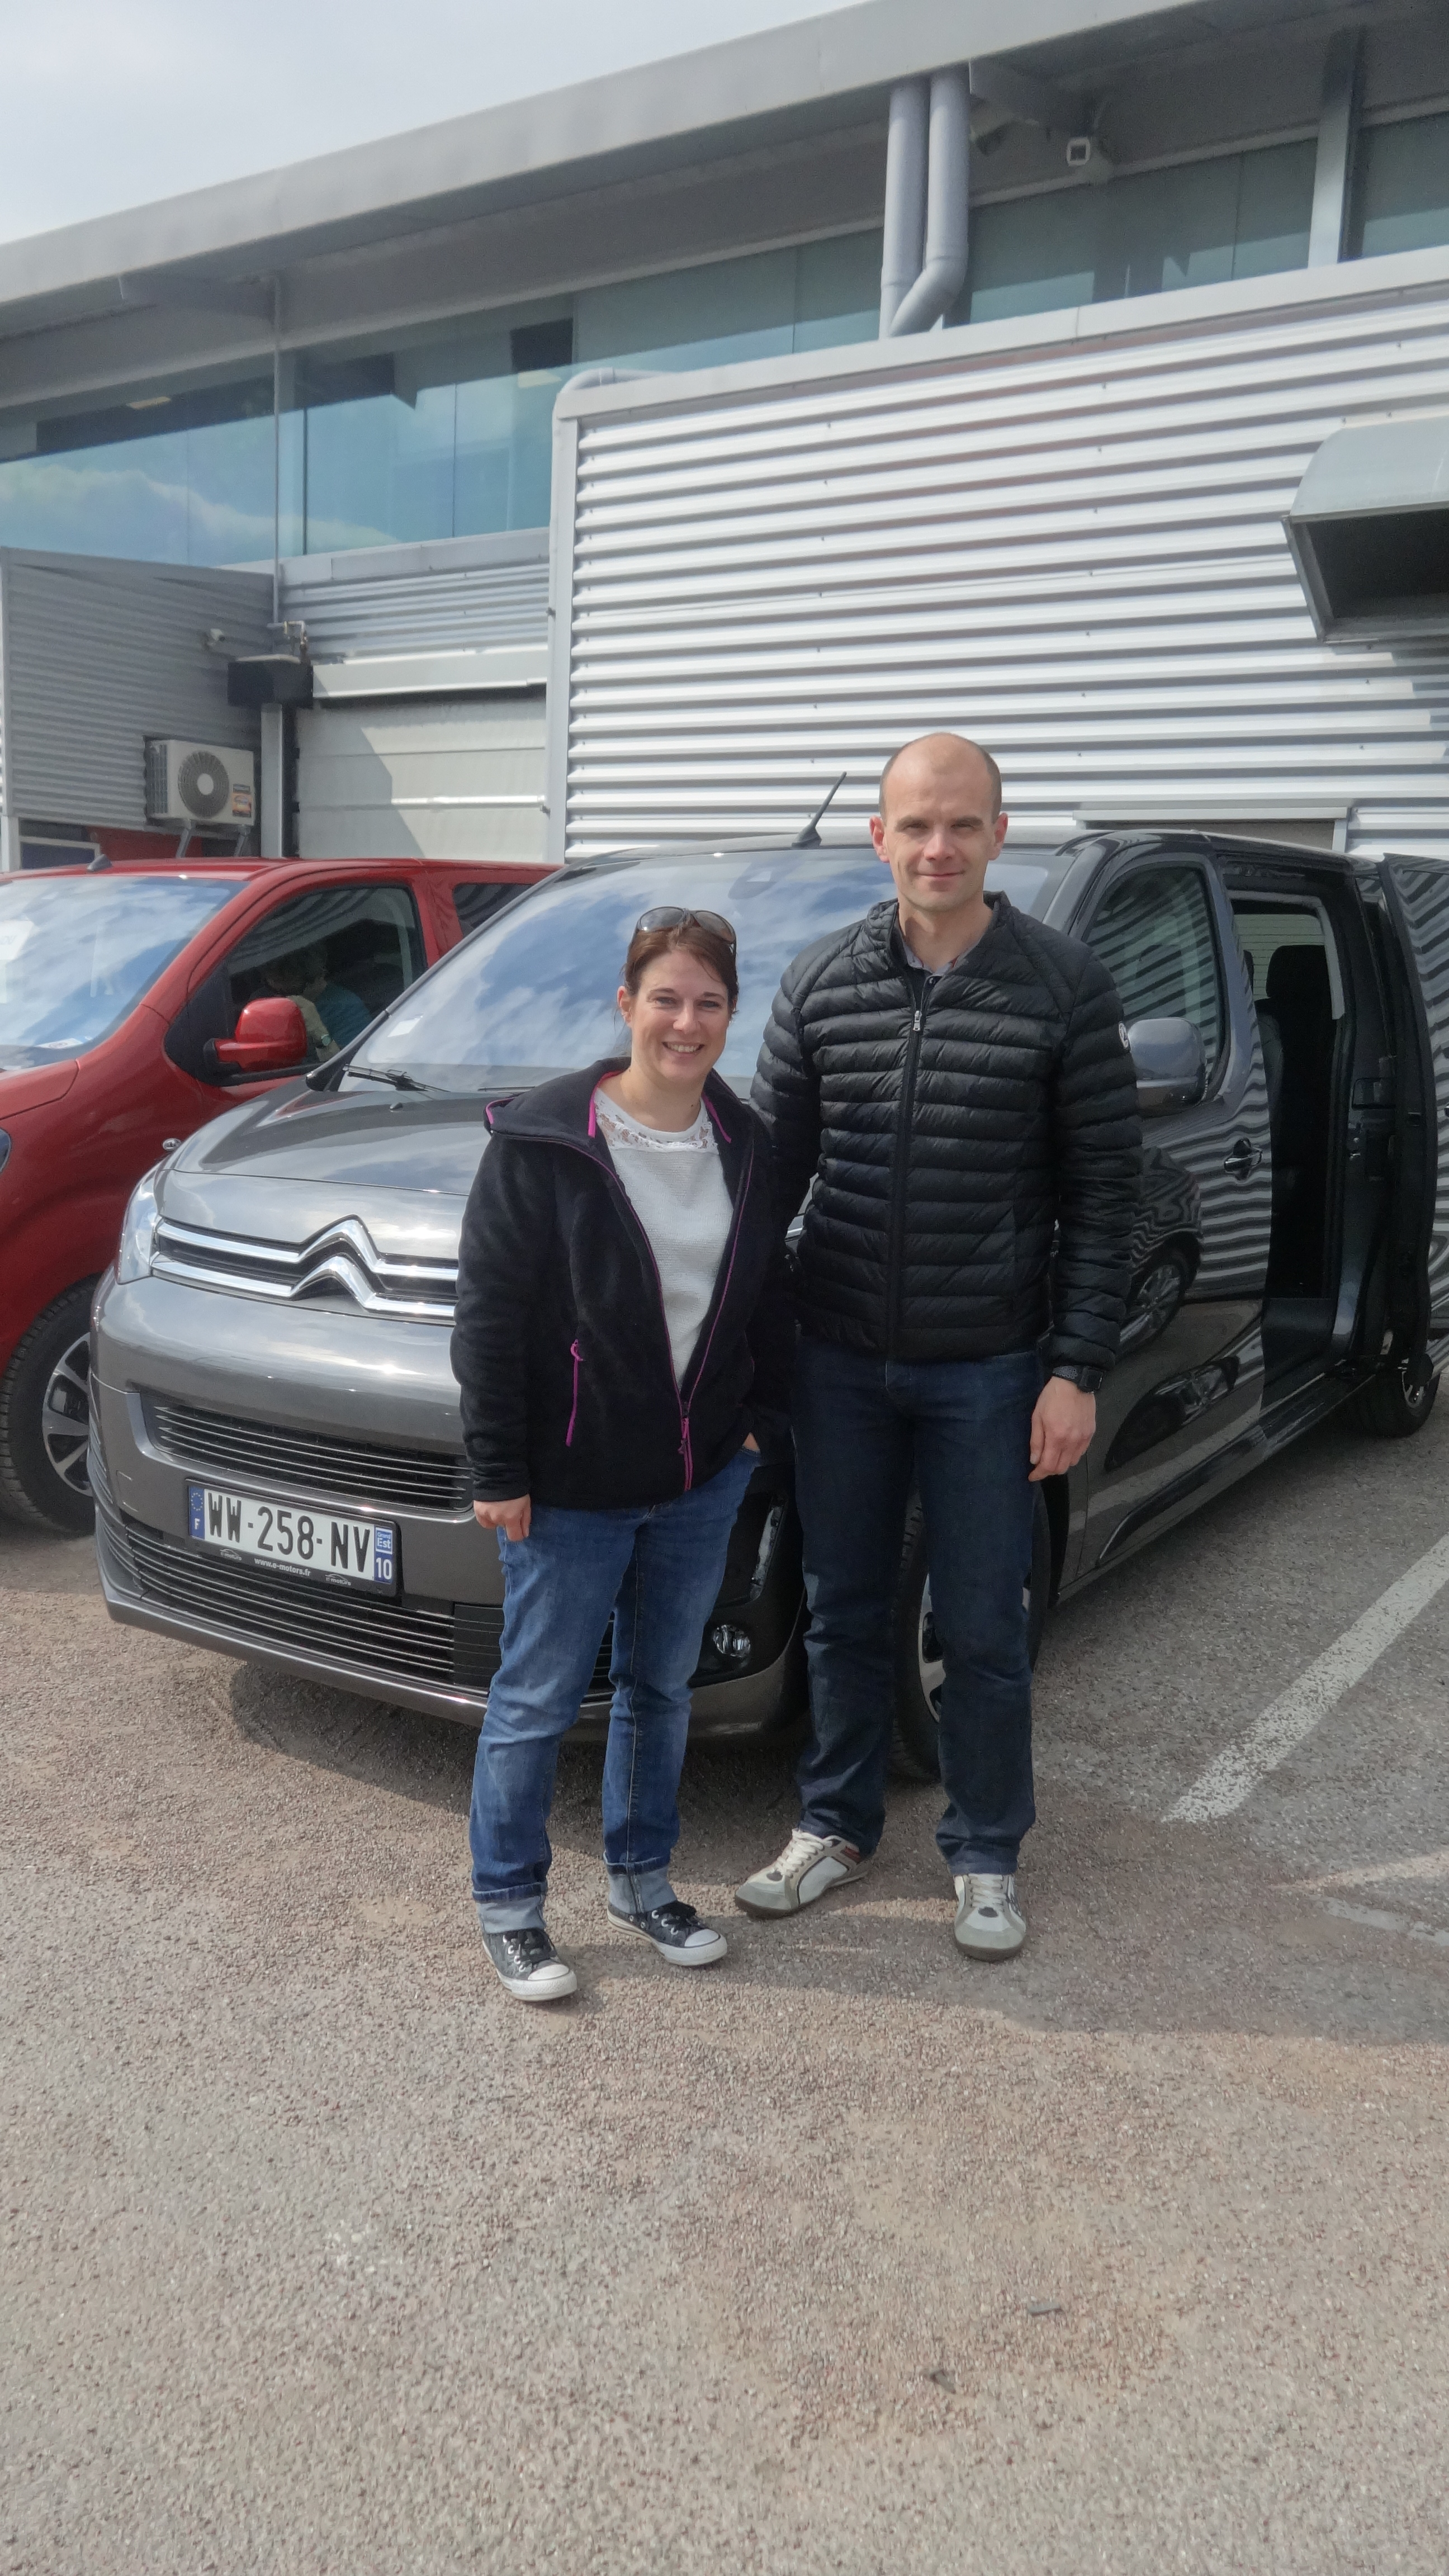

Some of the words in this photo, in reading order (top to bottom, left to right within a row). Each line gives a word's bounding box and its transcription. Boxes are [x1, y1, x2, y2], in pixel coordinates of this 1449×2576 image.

[195, 1518, 200, 1530] F
[207, 1493, 371, 1573] WW-258-NV
[377, 1537, 391, 1549] Est
[254, 1558, 311, 1576] www.e-motors.fr
[376, 1557, 392, 1579] 10
